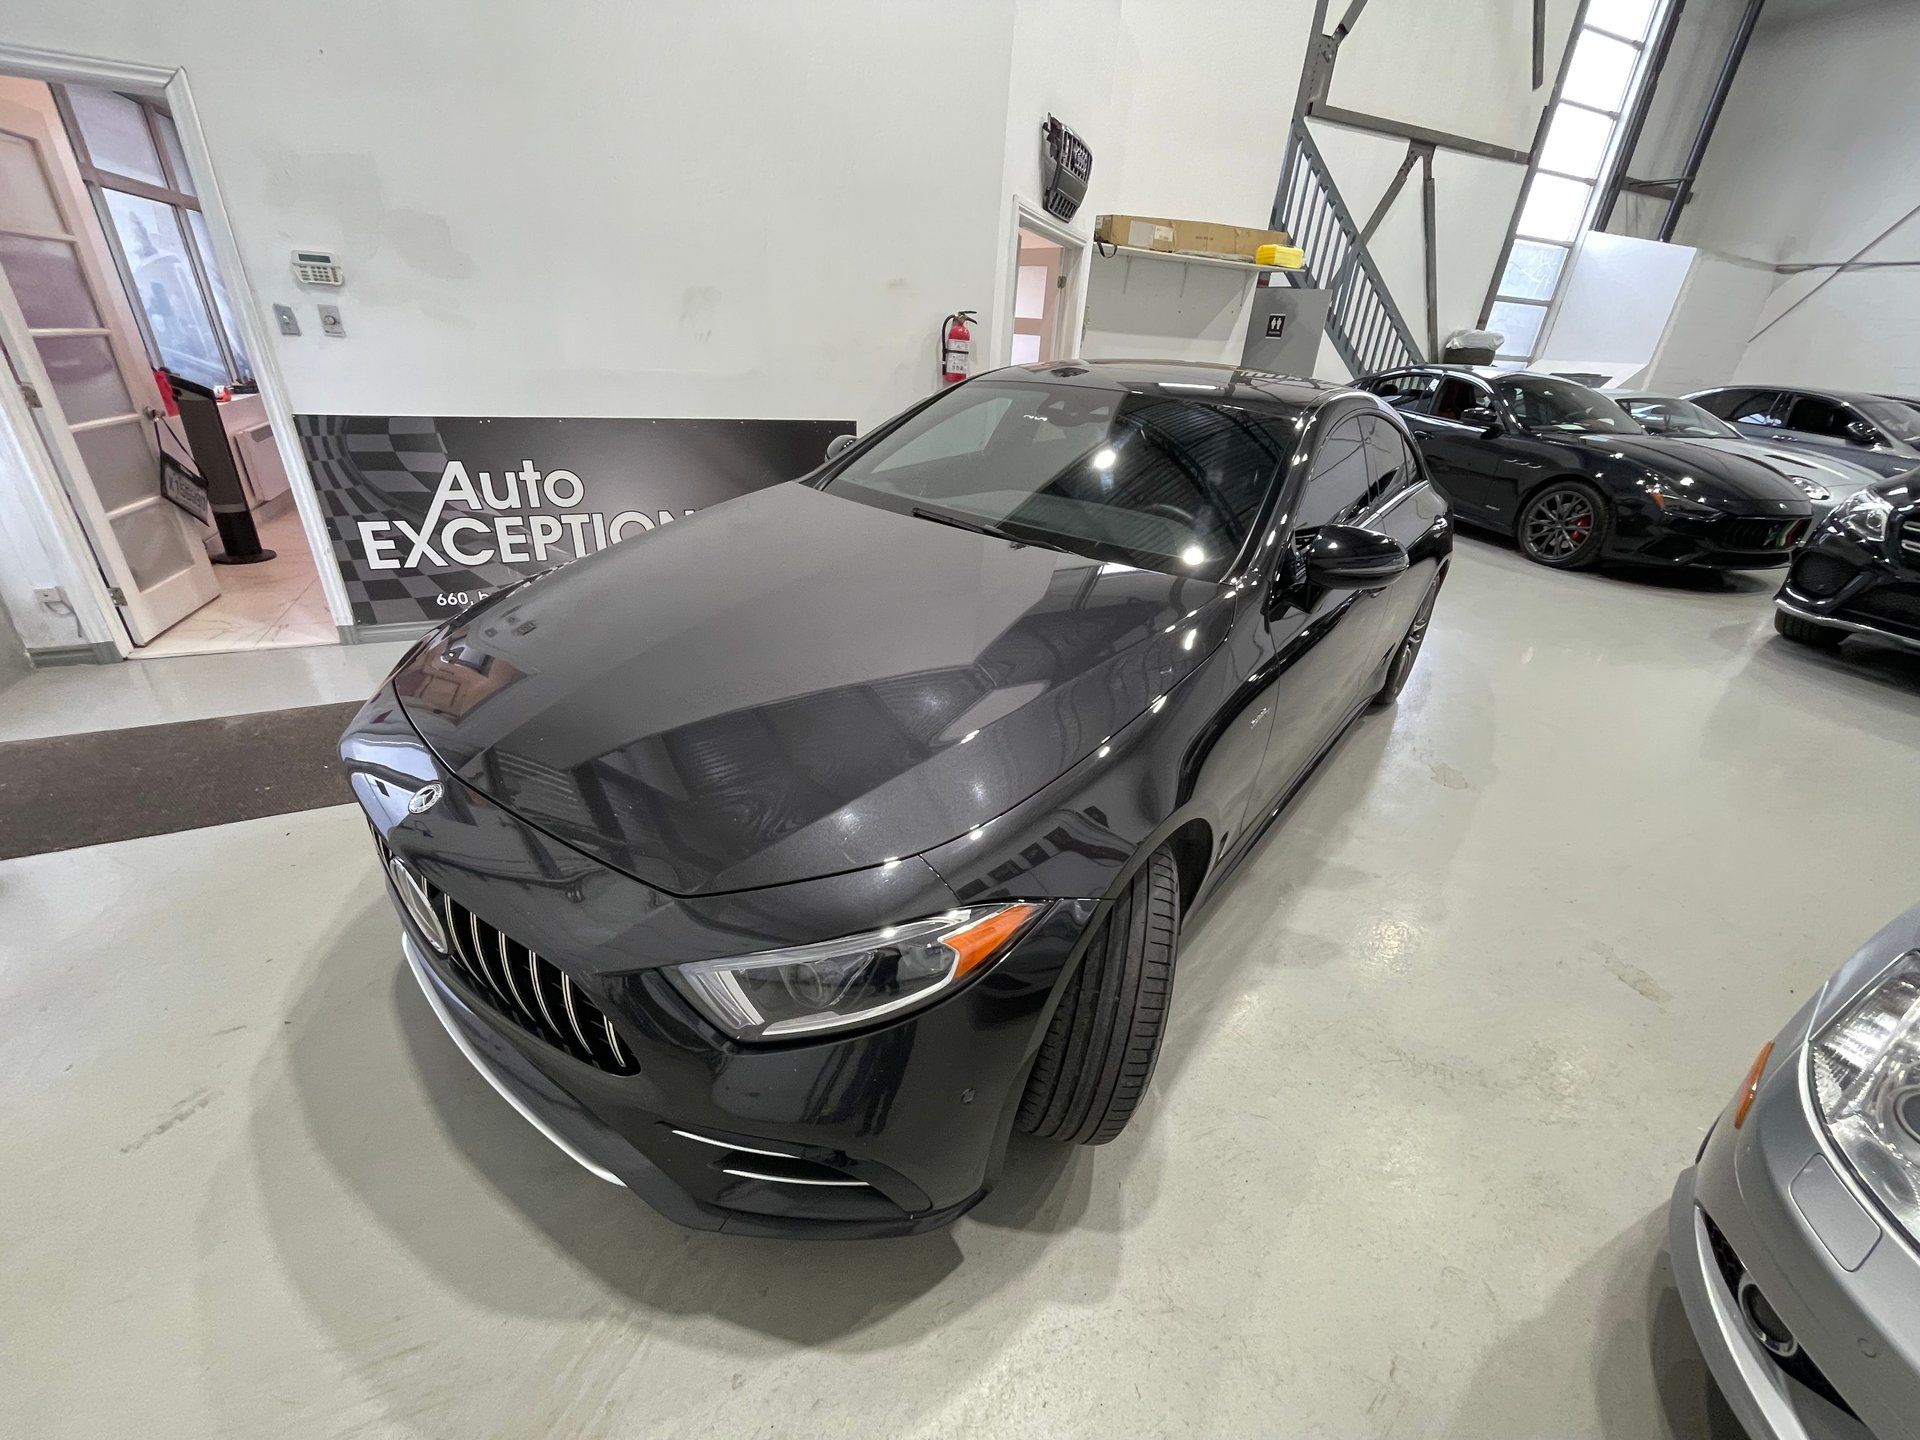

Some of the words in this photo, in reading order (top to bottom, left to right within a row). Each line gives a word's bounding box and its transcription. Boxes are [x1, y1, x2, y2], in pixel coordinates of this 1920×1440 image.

[430, 459, 585, 511] Auto
[356, 510, 696, 570] EXCEPTIO
[436, 591, 474, 607] 660,
